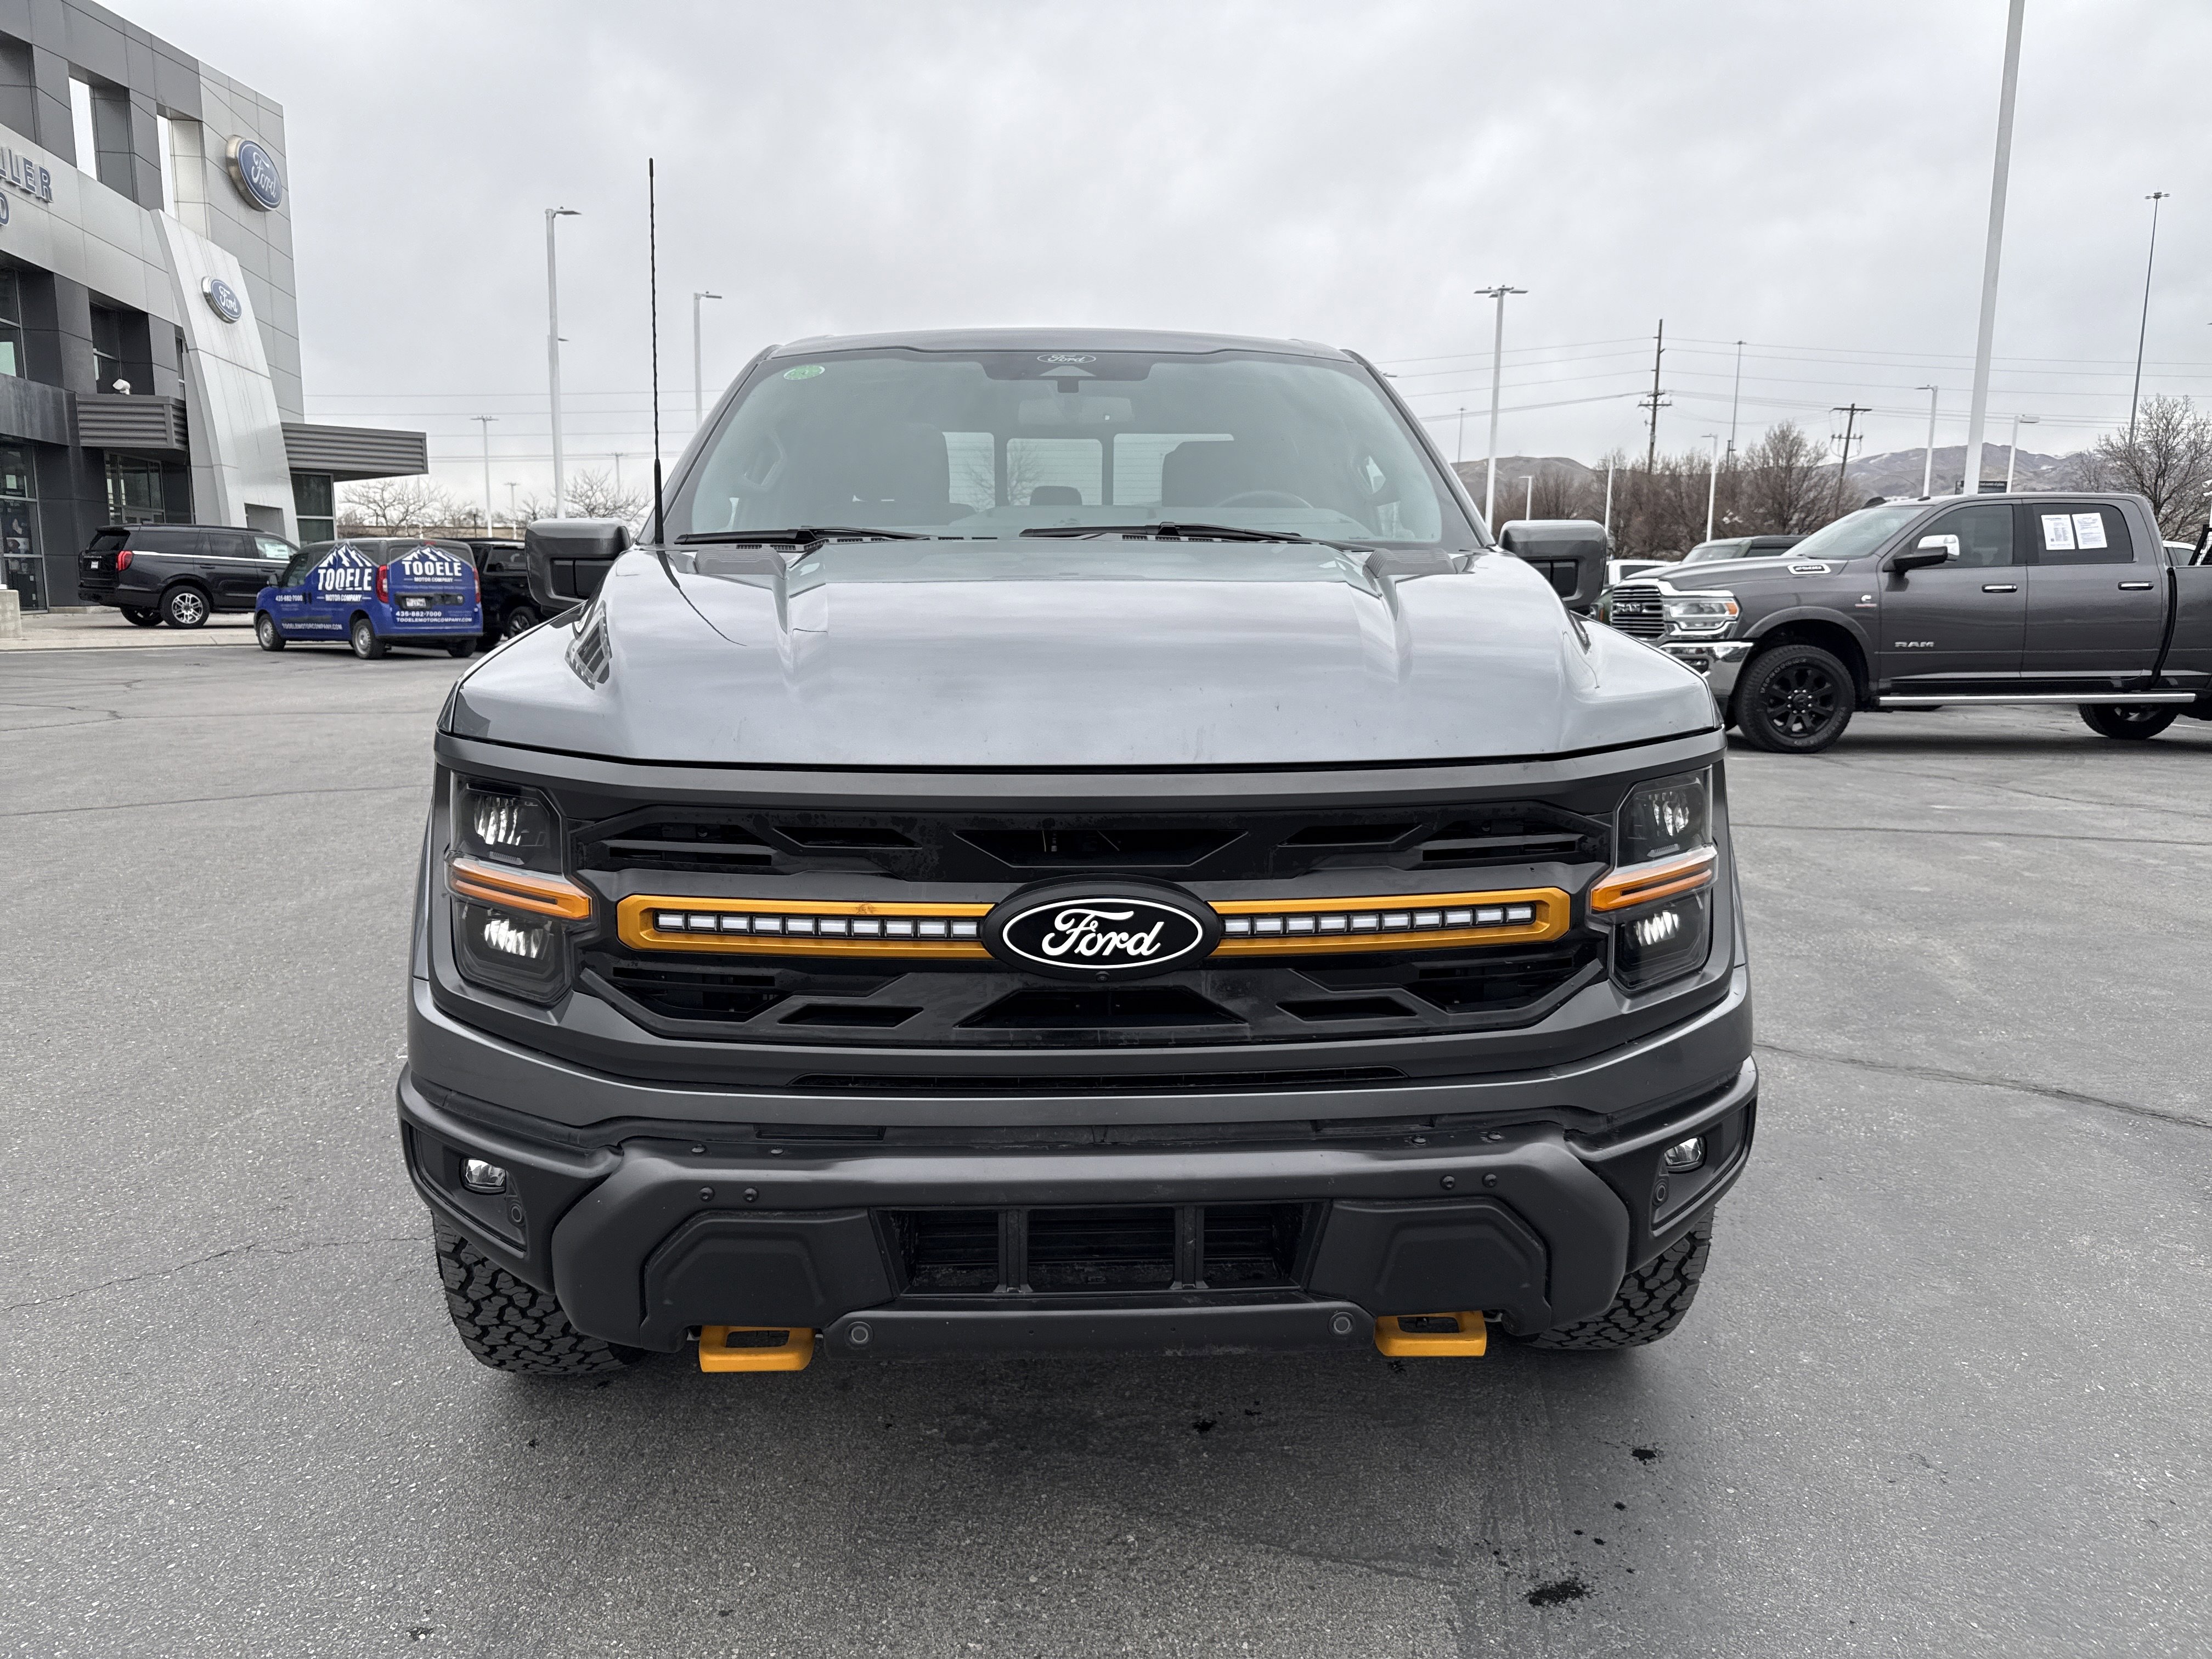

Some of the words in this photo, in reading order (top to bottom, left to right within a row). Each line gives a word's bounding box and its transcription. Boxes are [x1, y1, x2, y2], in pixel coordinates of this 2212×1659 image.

[251, 151, 276, 198] Ford
[218, 285, 238, 313] Ford
[318, 568, 372, 591] TOOELE
[402, 561, 462, 577] TOOELE
[1042, 908, 1165, 956] Ford
